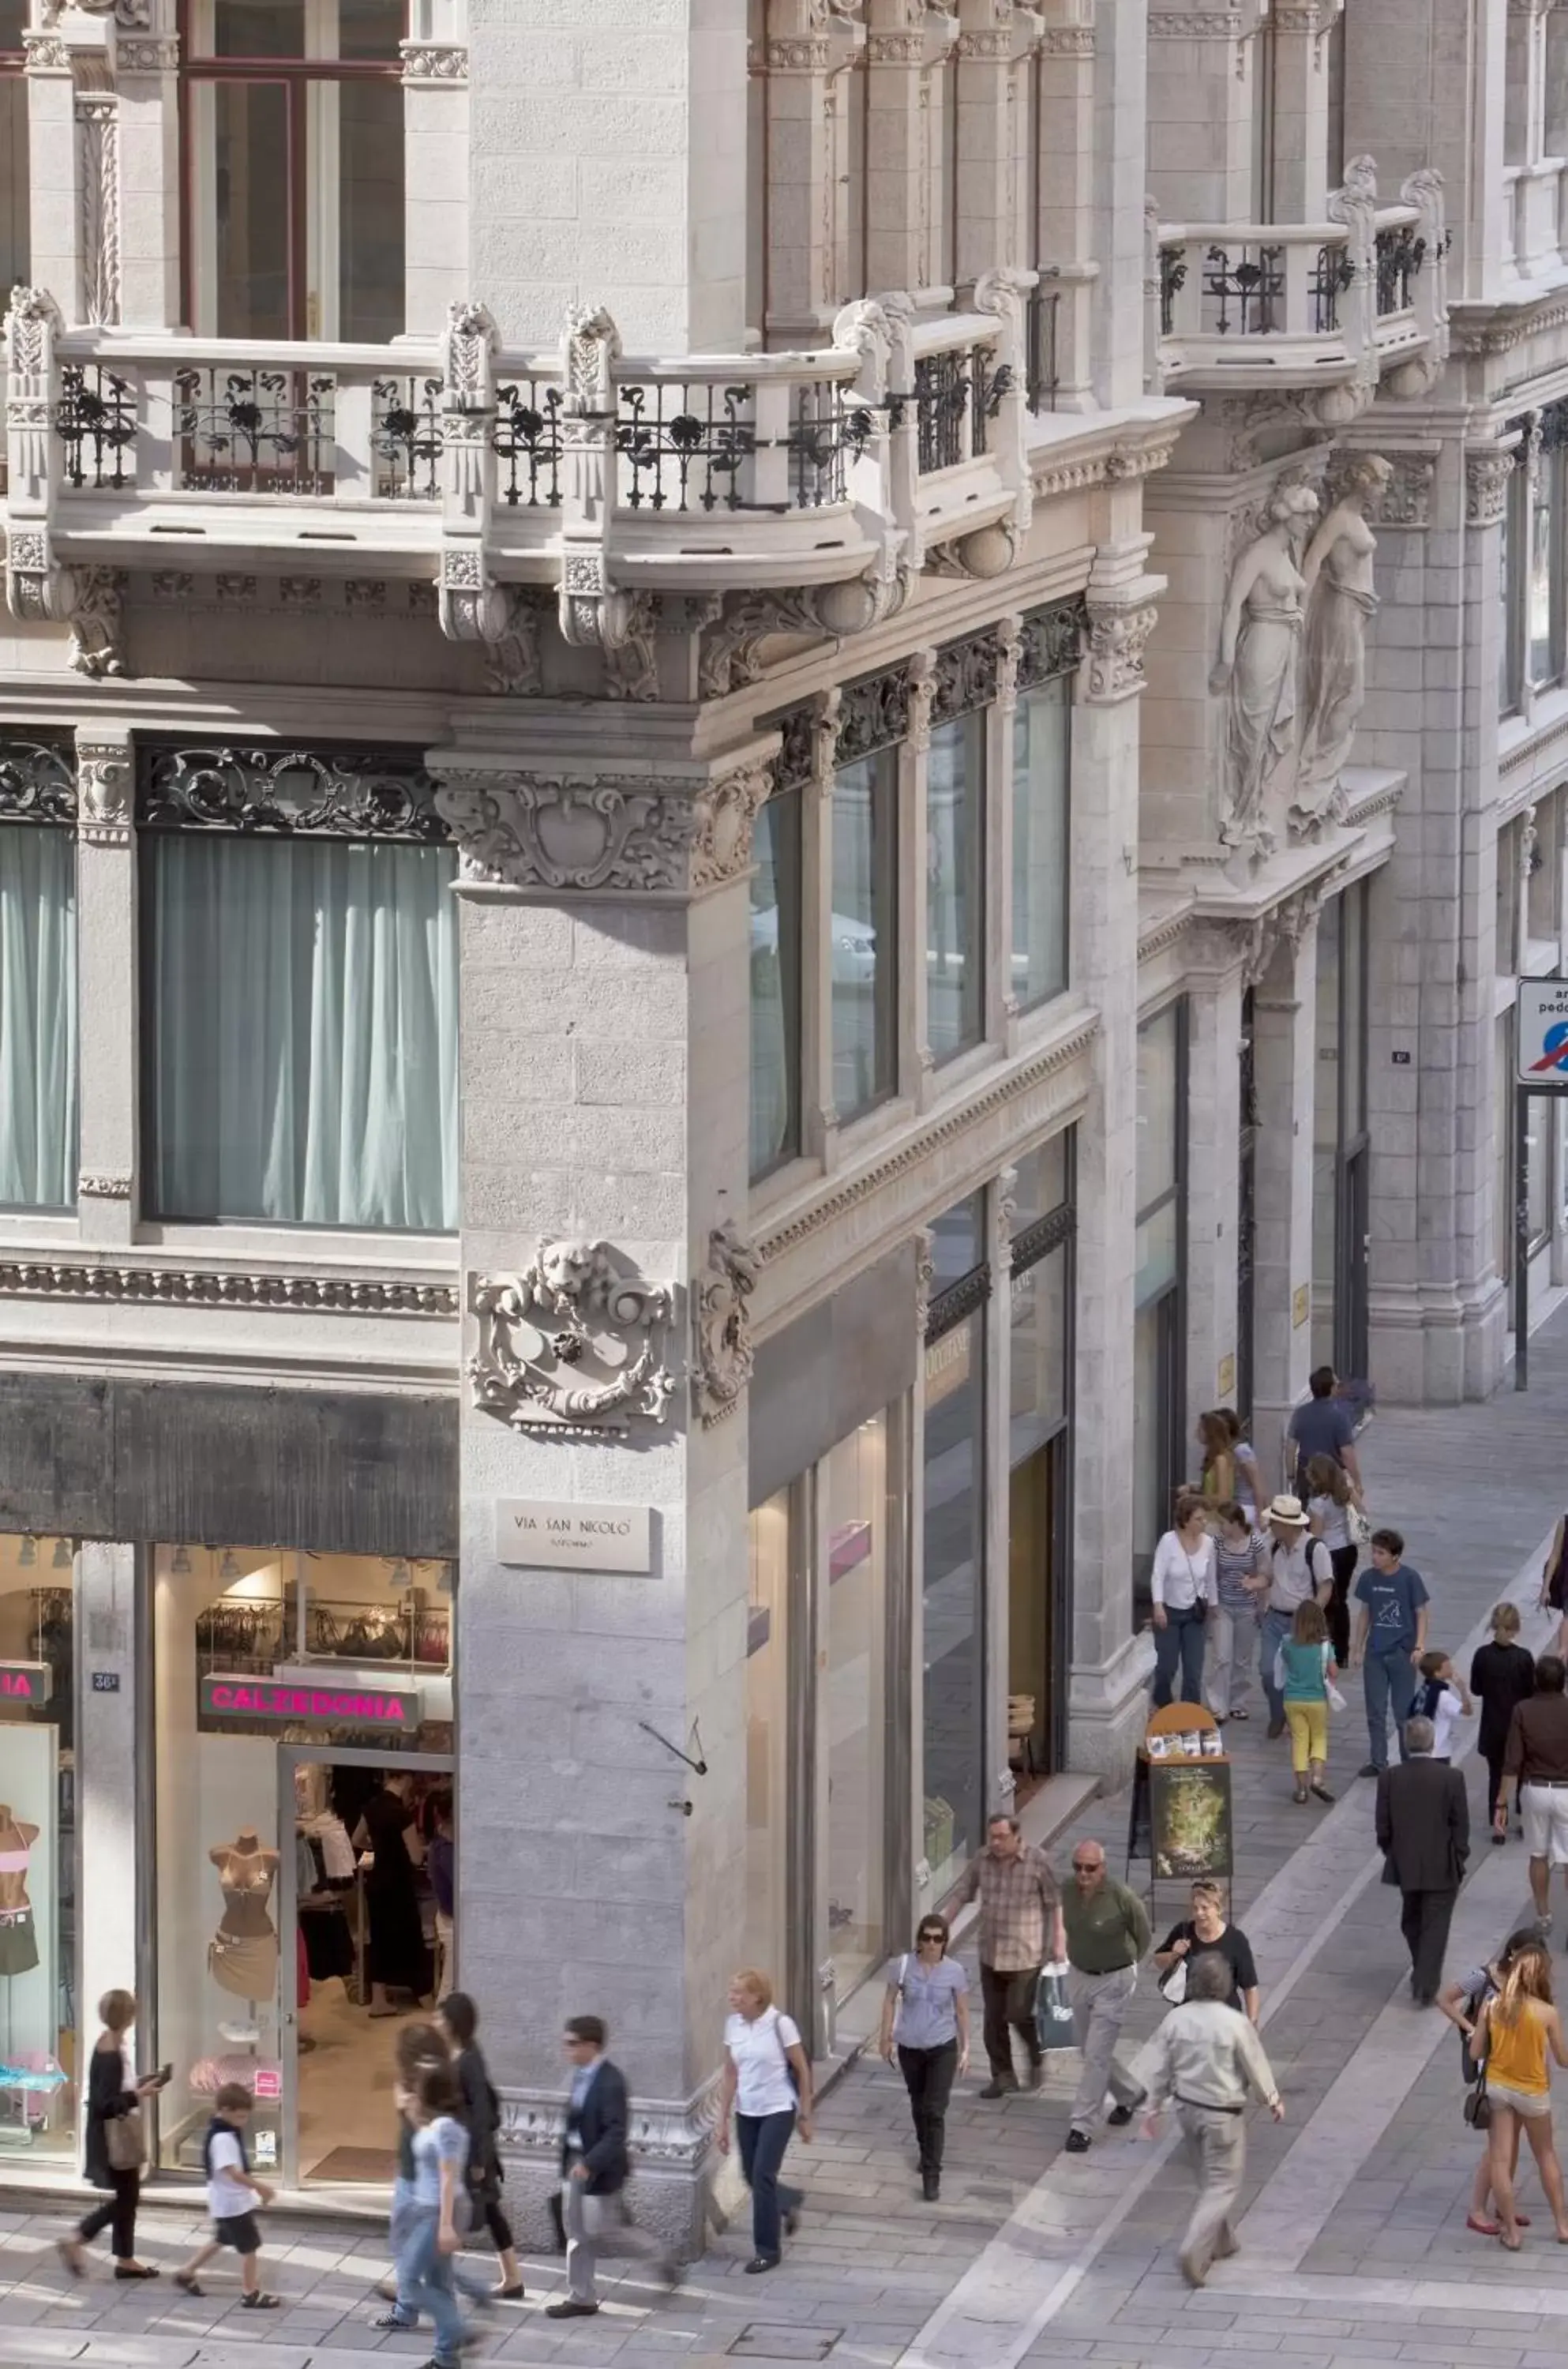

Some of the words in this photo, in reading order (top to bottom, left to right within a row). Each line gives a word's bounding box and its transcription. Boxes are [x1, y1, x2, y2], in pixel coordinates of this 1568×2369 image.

[514, 1515, 537, 1530] VIA
[546, 1518, 571, 1532] SAN
[211, 1685, 406, 1721] CALZEDONIA
